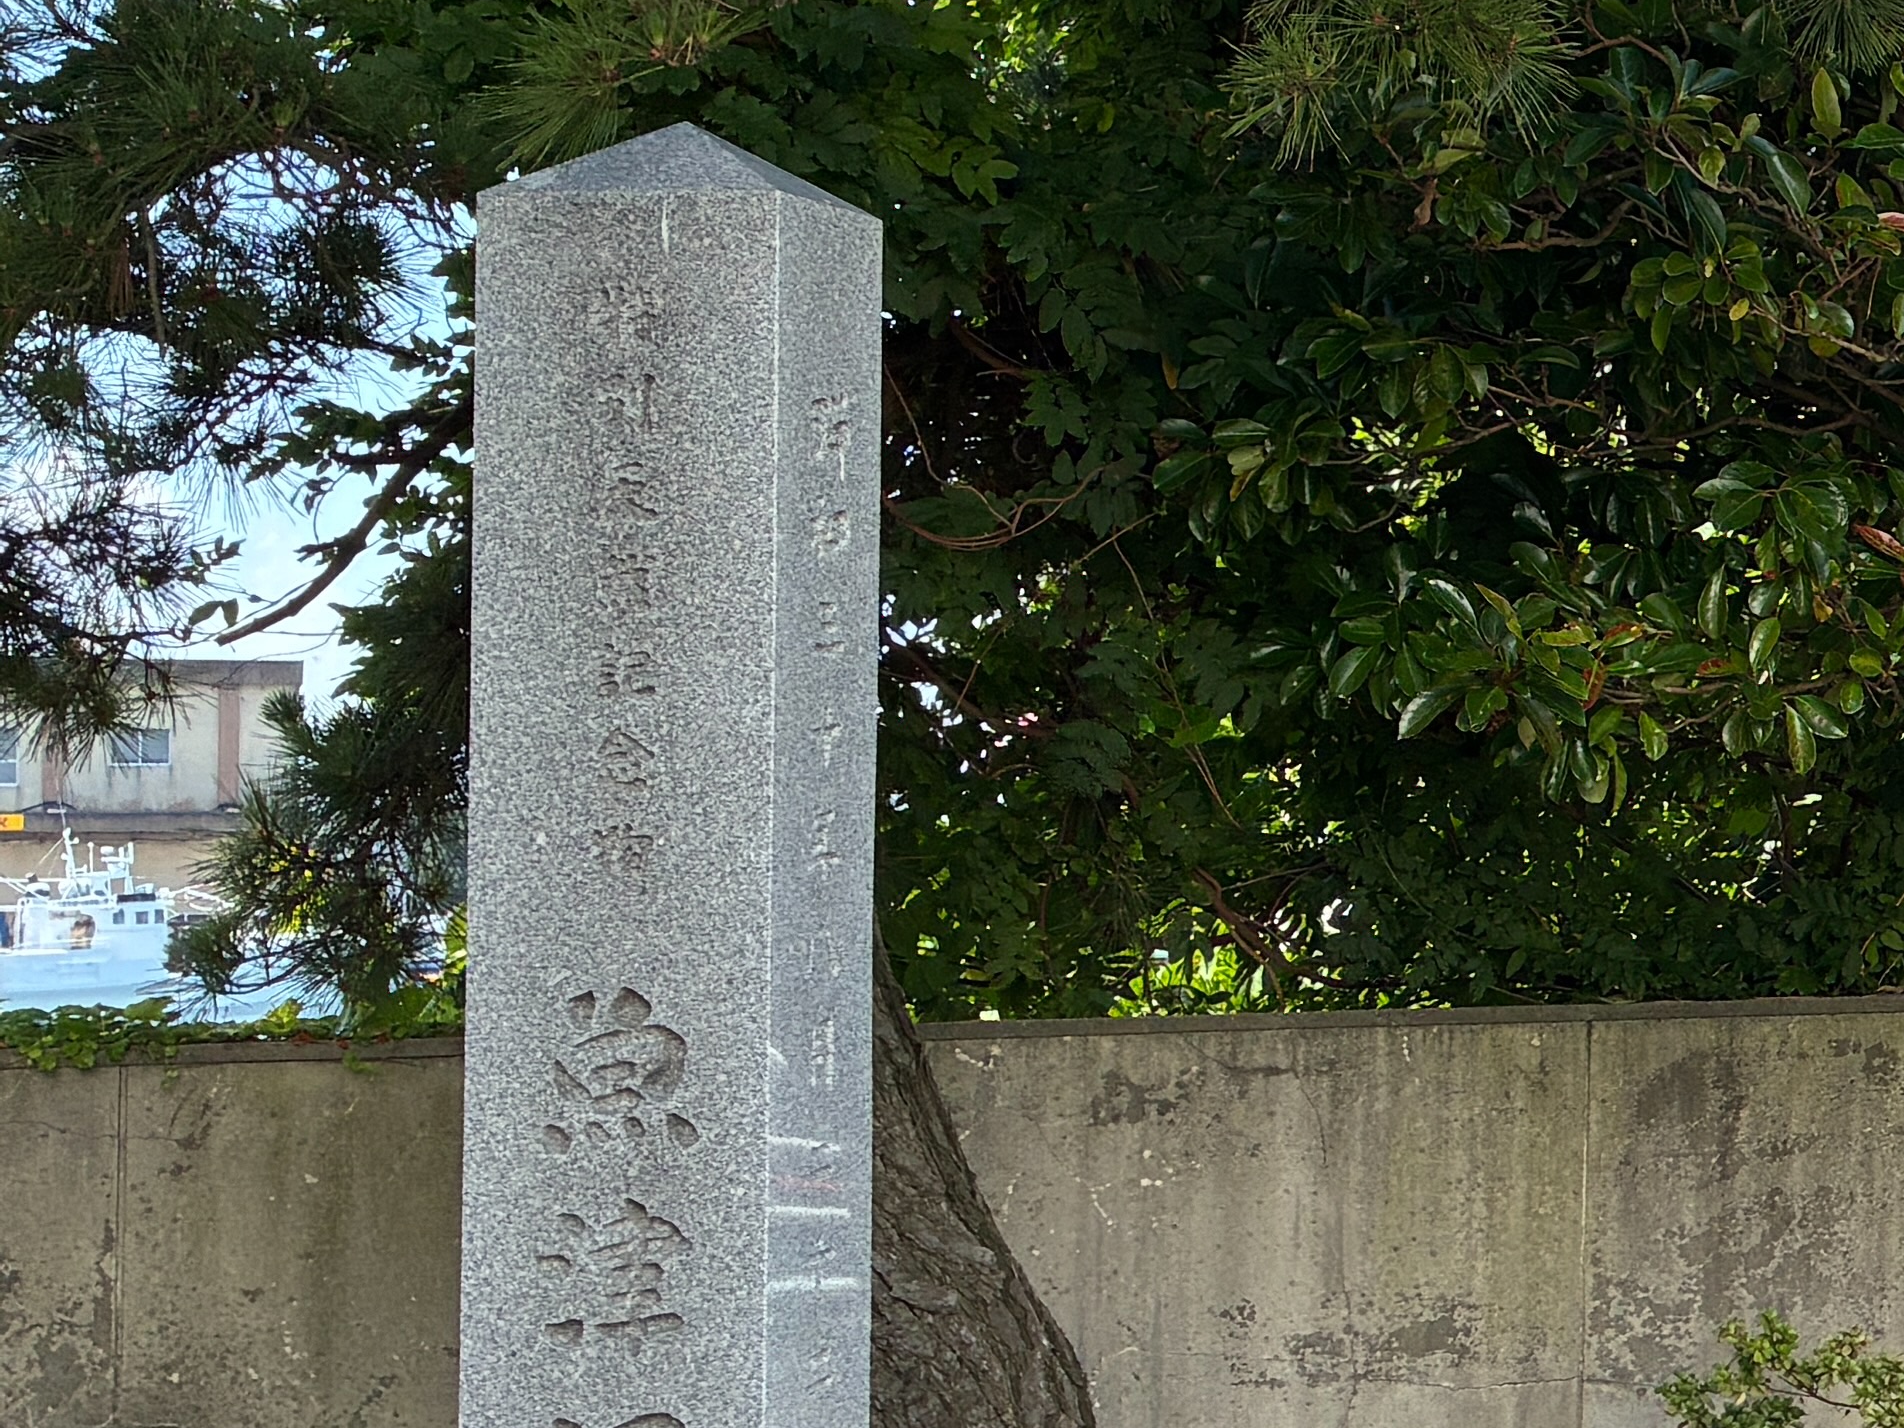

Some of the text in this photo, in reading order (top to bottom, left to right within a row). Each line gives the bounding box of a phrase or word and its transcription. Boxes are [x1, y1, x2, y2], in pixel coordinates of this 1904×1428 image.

[584, 277, 665, 892] 特別天然記念物
